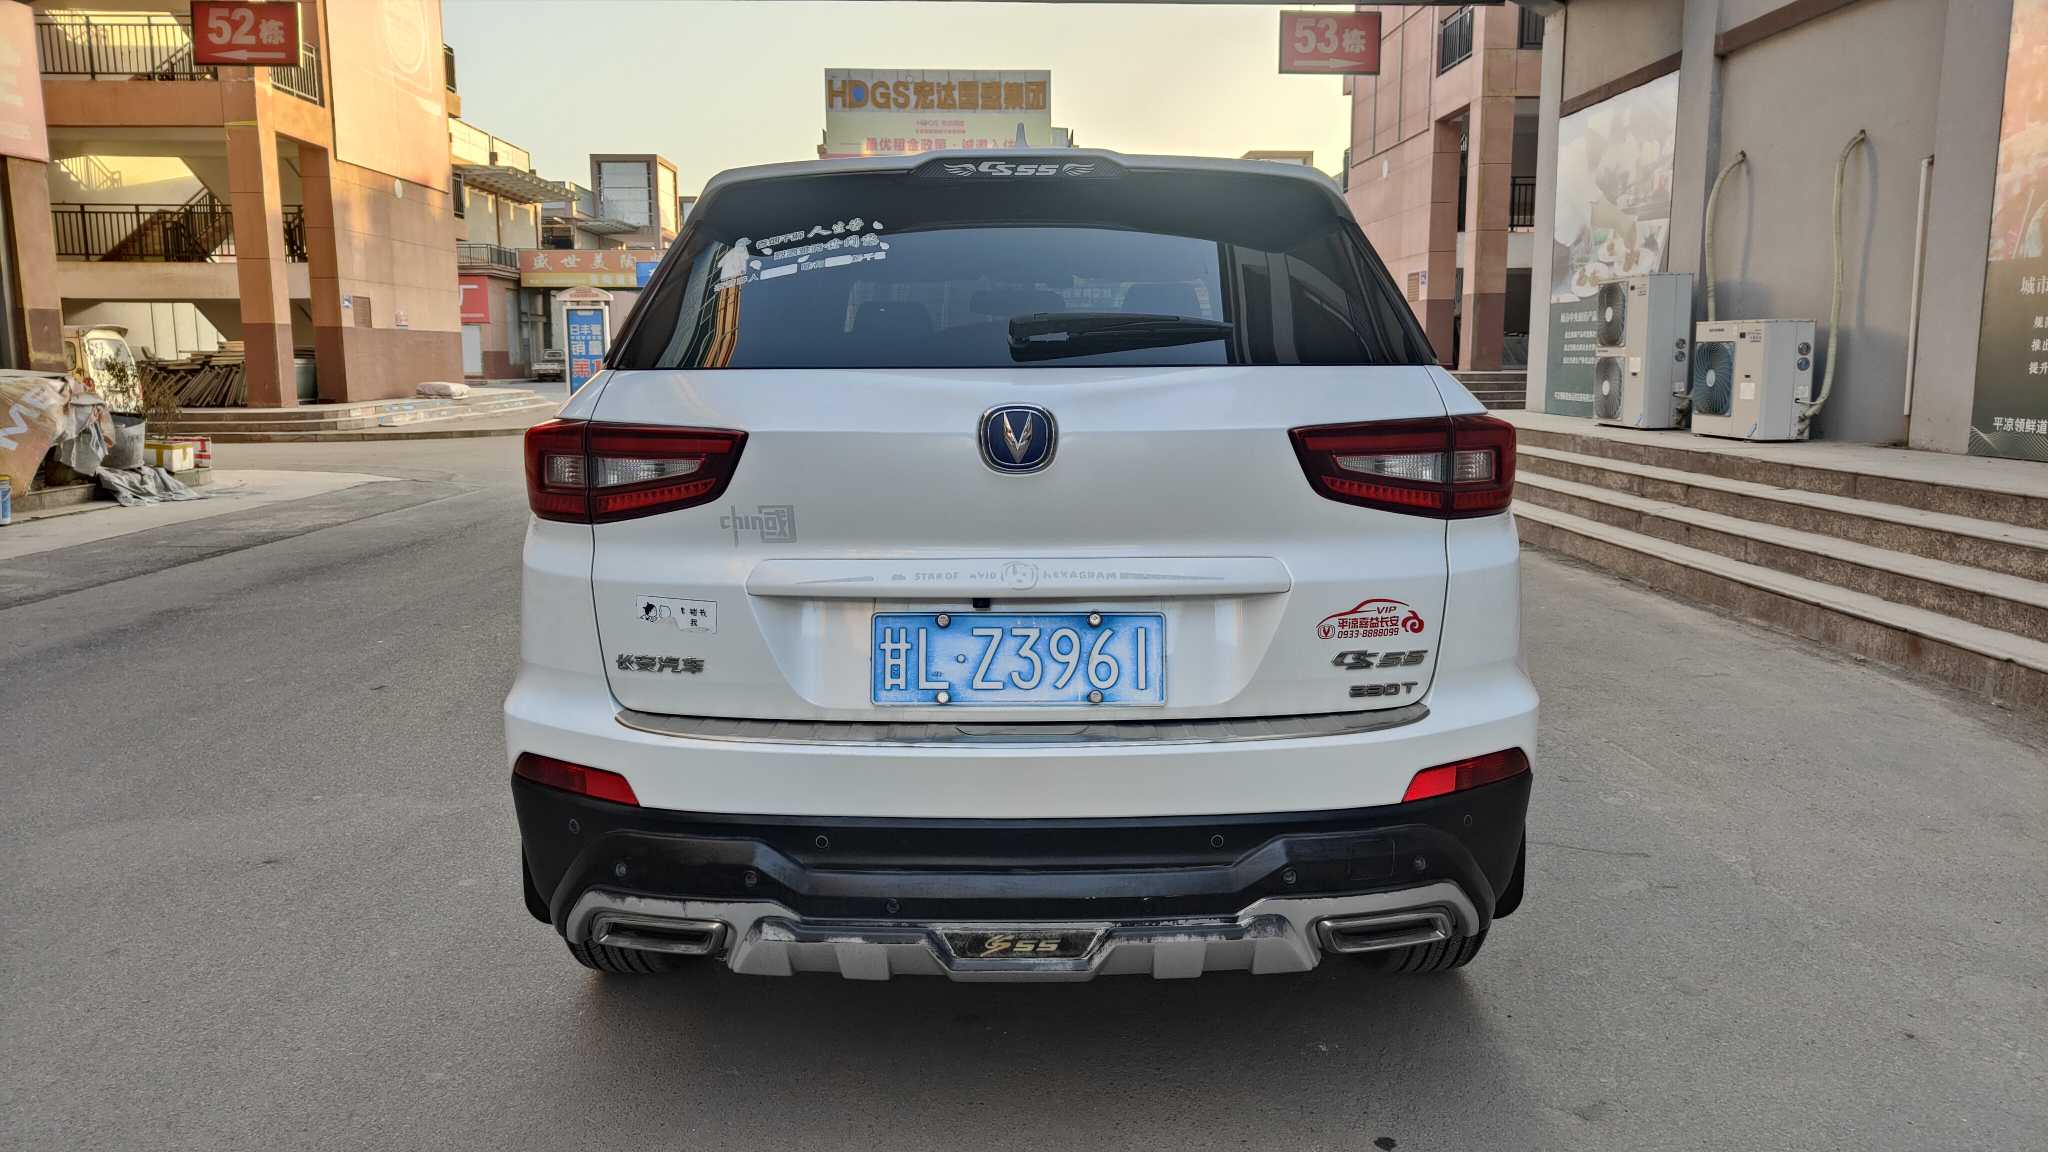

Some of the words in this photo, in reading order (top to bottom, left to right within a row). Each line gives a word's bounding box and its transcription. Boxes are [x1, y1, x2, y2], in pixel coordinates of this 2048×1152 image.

[1992, 416, 2048, 435] 平凉领鲜道
[1375, 605, 1398, 615] VIP
[616, 653, 705, 674] 长安汽车
